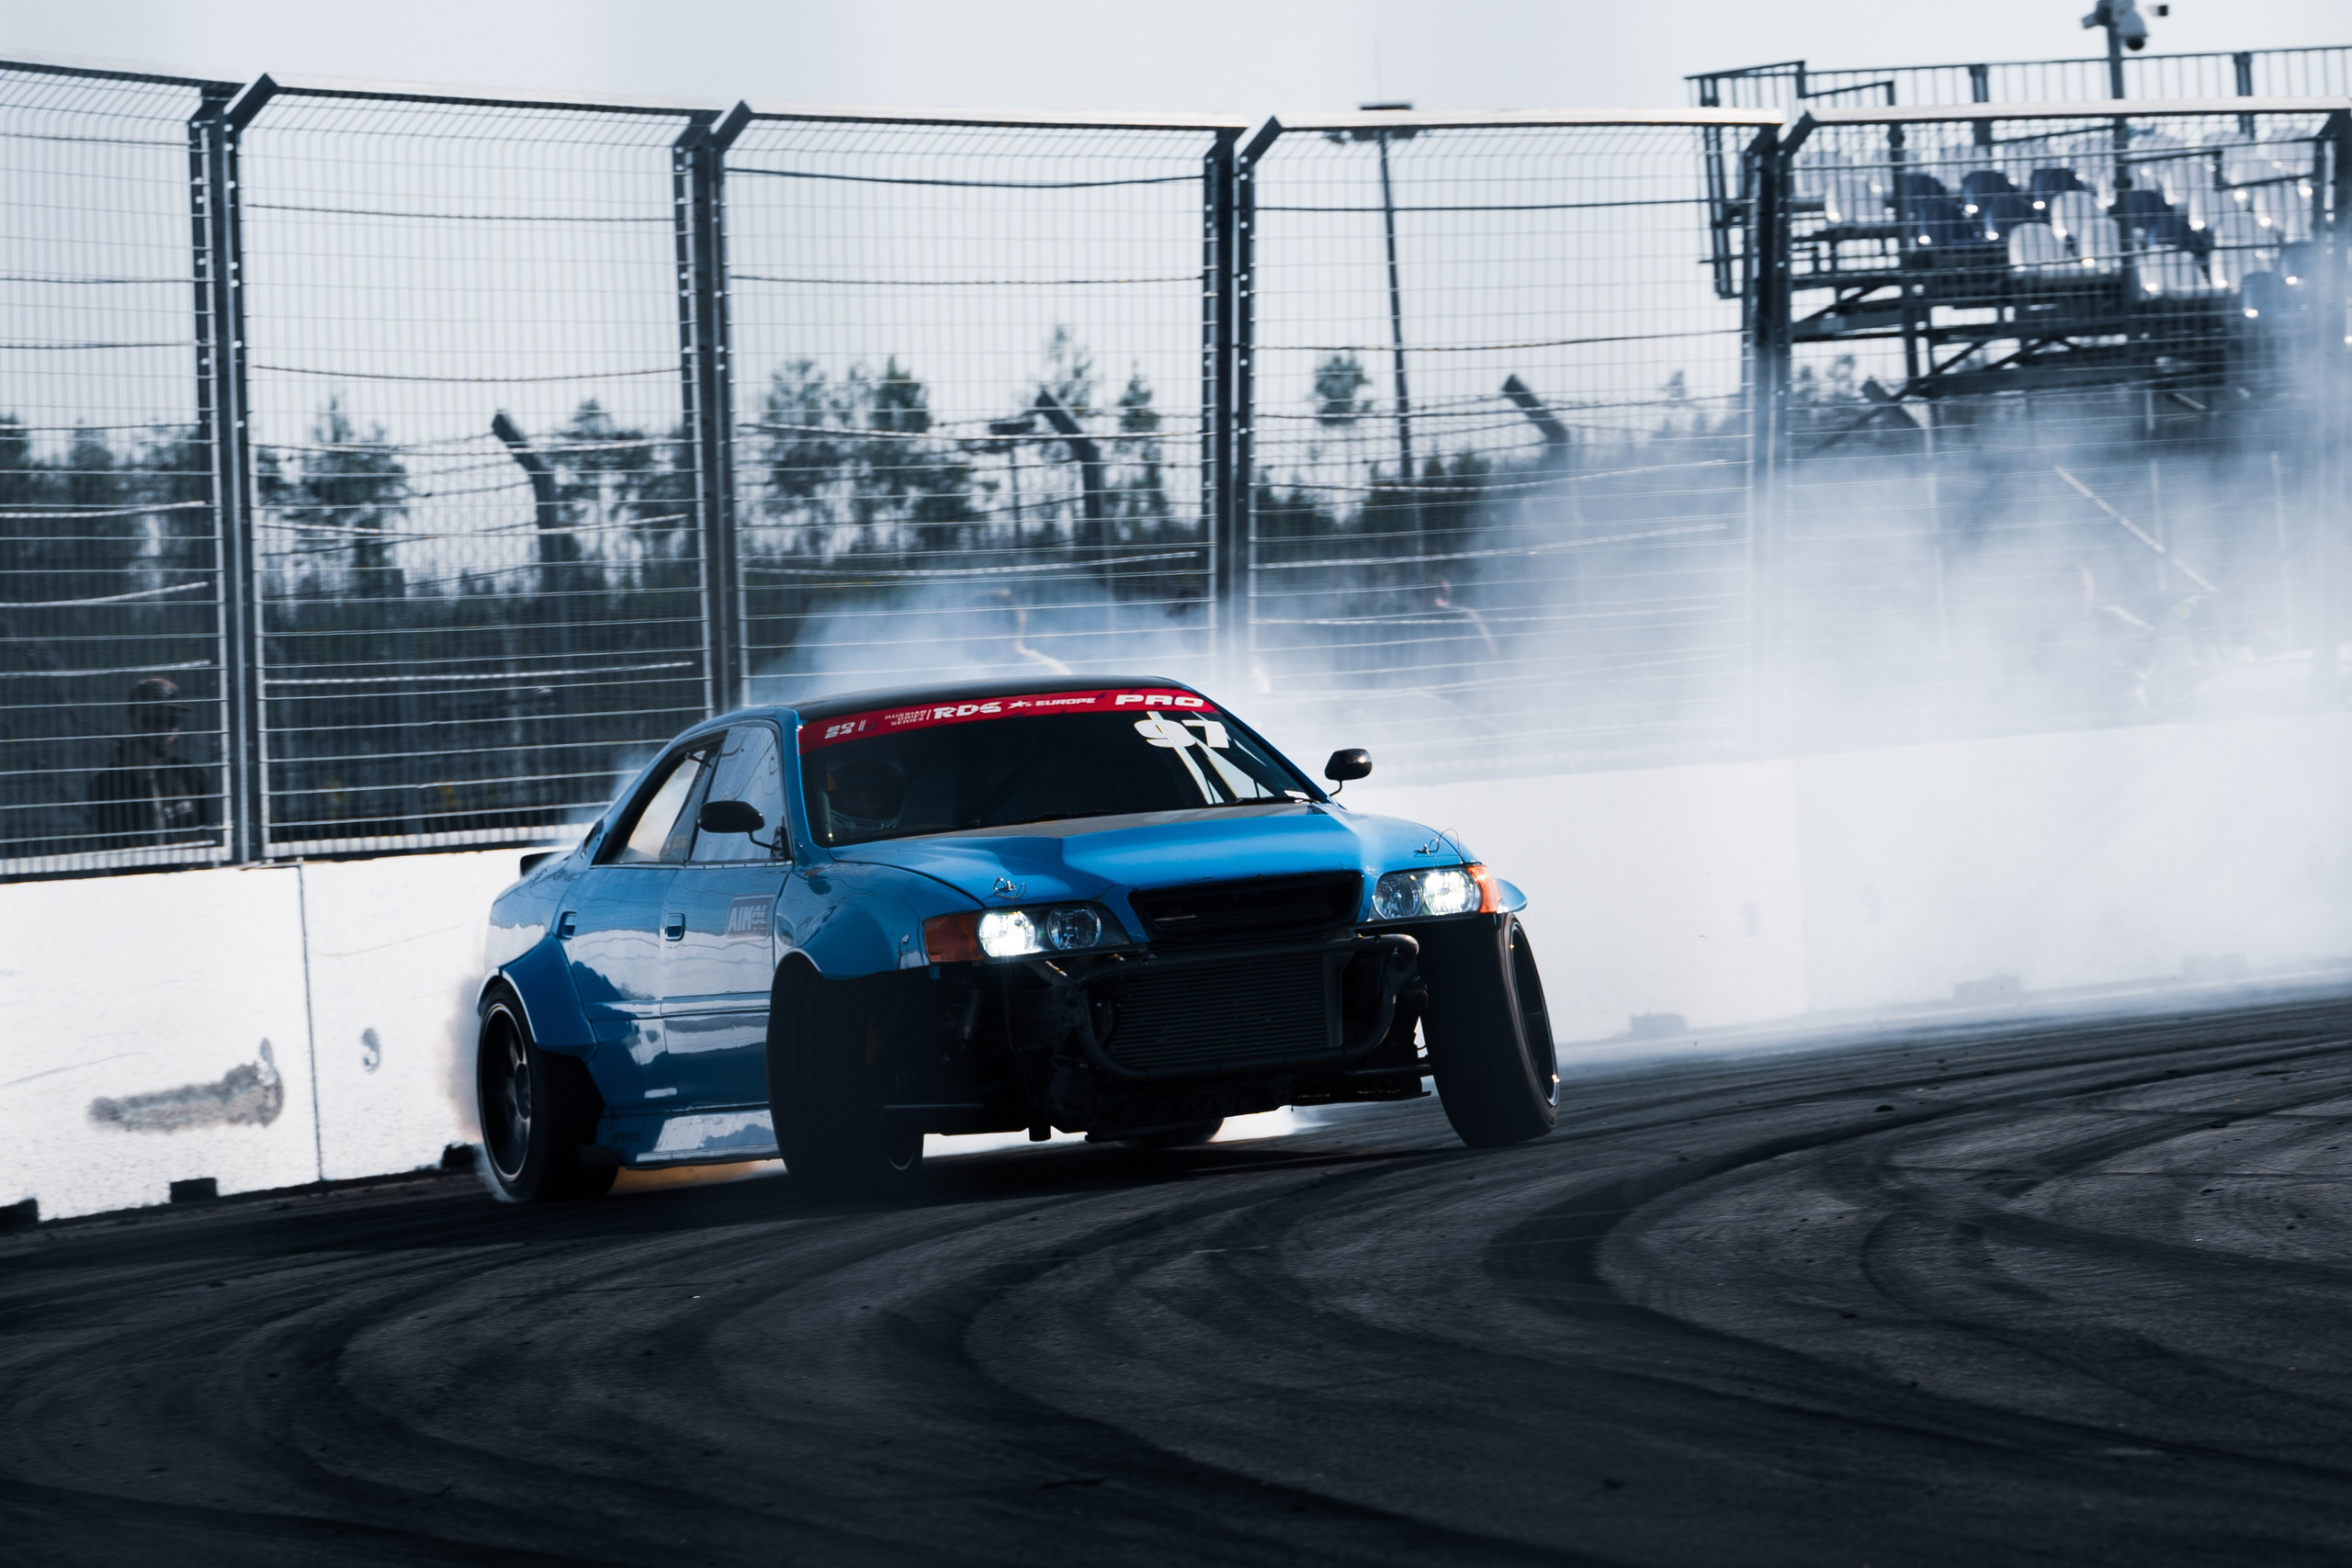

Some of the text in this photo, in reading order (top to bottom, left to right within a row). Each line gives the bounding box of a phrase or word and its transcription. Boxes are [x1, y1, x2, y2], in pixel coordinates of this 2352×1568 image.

[1035, 697, 1096, 706] EUROPE
[1115, 694, 1204, 707] PRO
[933, 701, 1002, 719] RDS
[1134, 719, 1229, 748] 97
